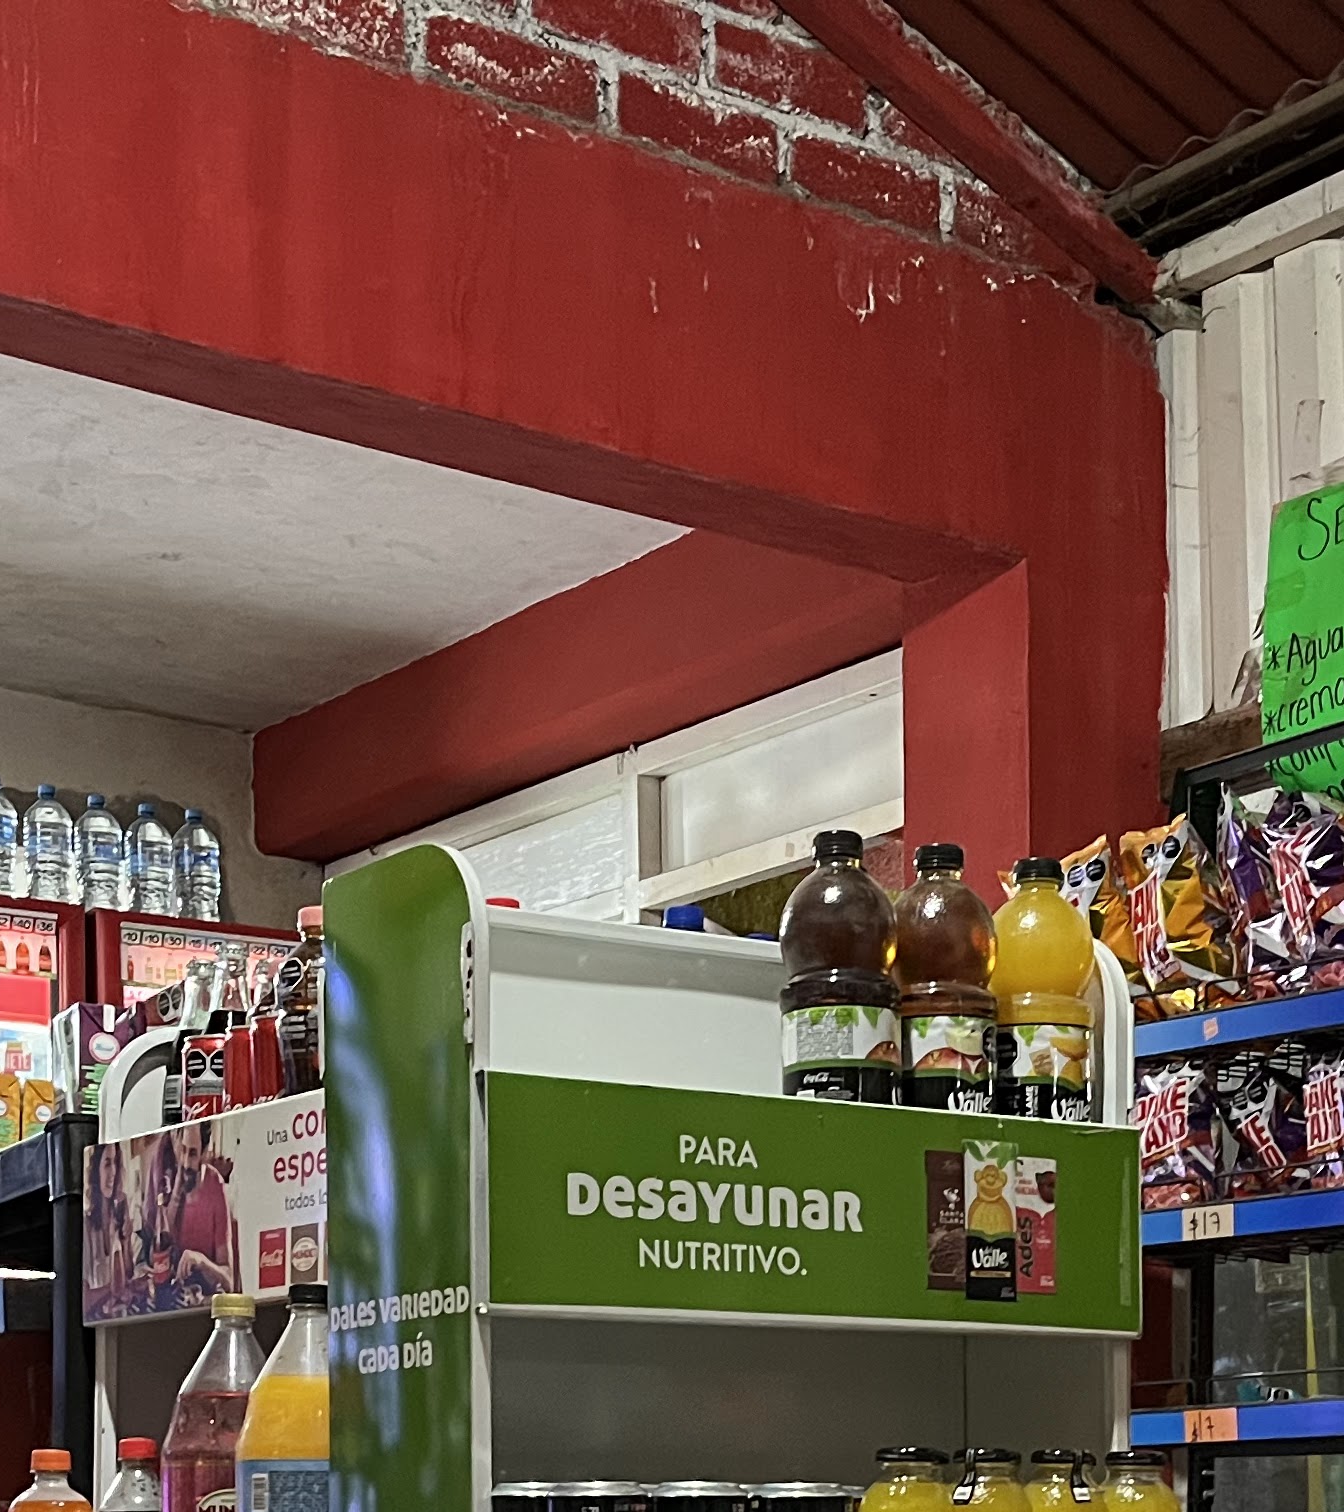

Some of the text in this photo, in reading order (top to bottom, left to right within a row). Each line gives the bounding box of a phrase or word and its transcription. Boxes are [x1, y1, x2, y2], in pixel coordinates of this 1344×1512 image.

[267, 1129, 288, 1146] Una
[680, 1134, 758, 1169] PARA
[273, 1146, 327, 1187] espe
[285, 1194, 315, 1211] todos
[639, 1238, 808, 1277] NUTRITIVO.
